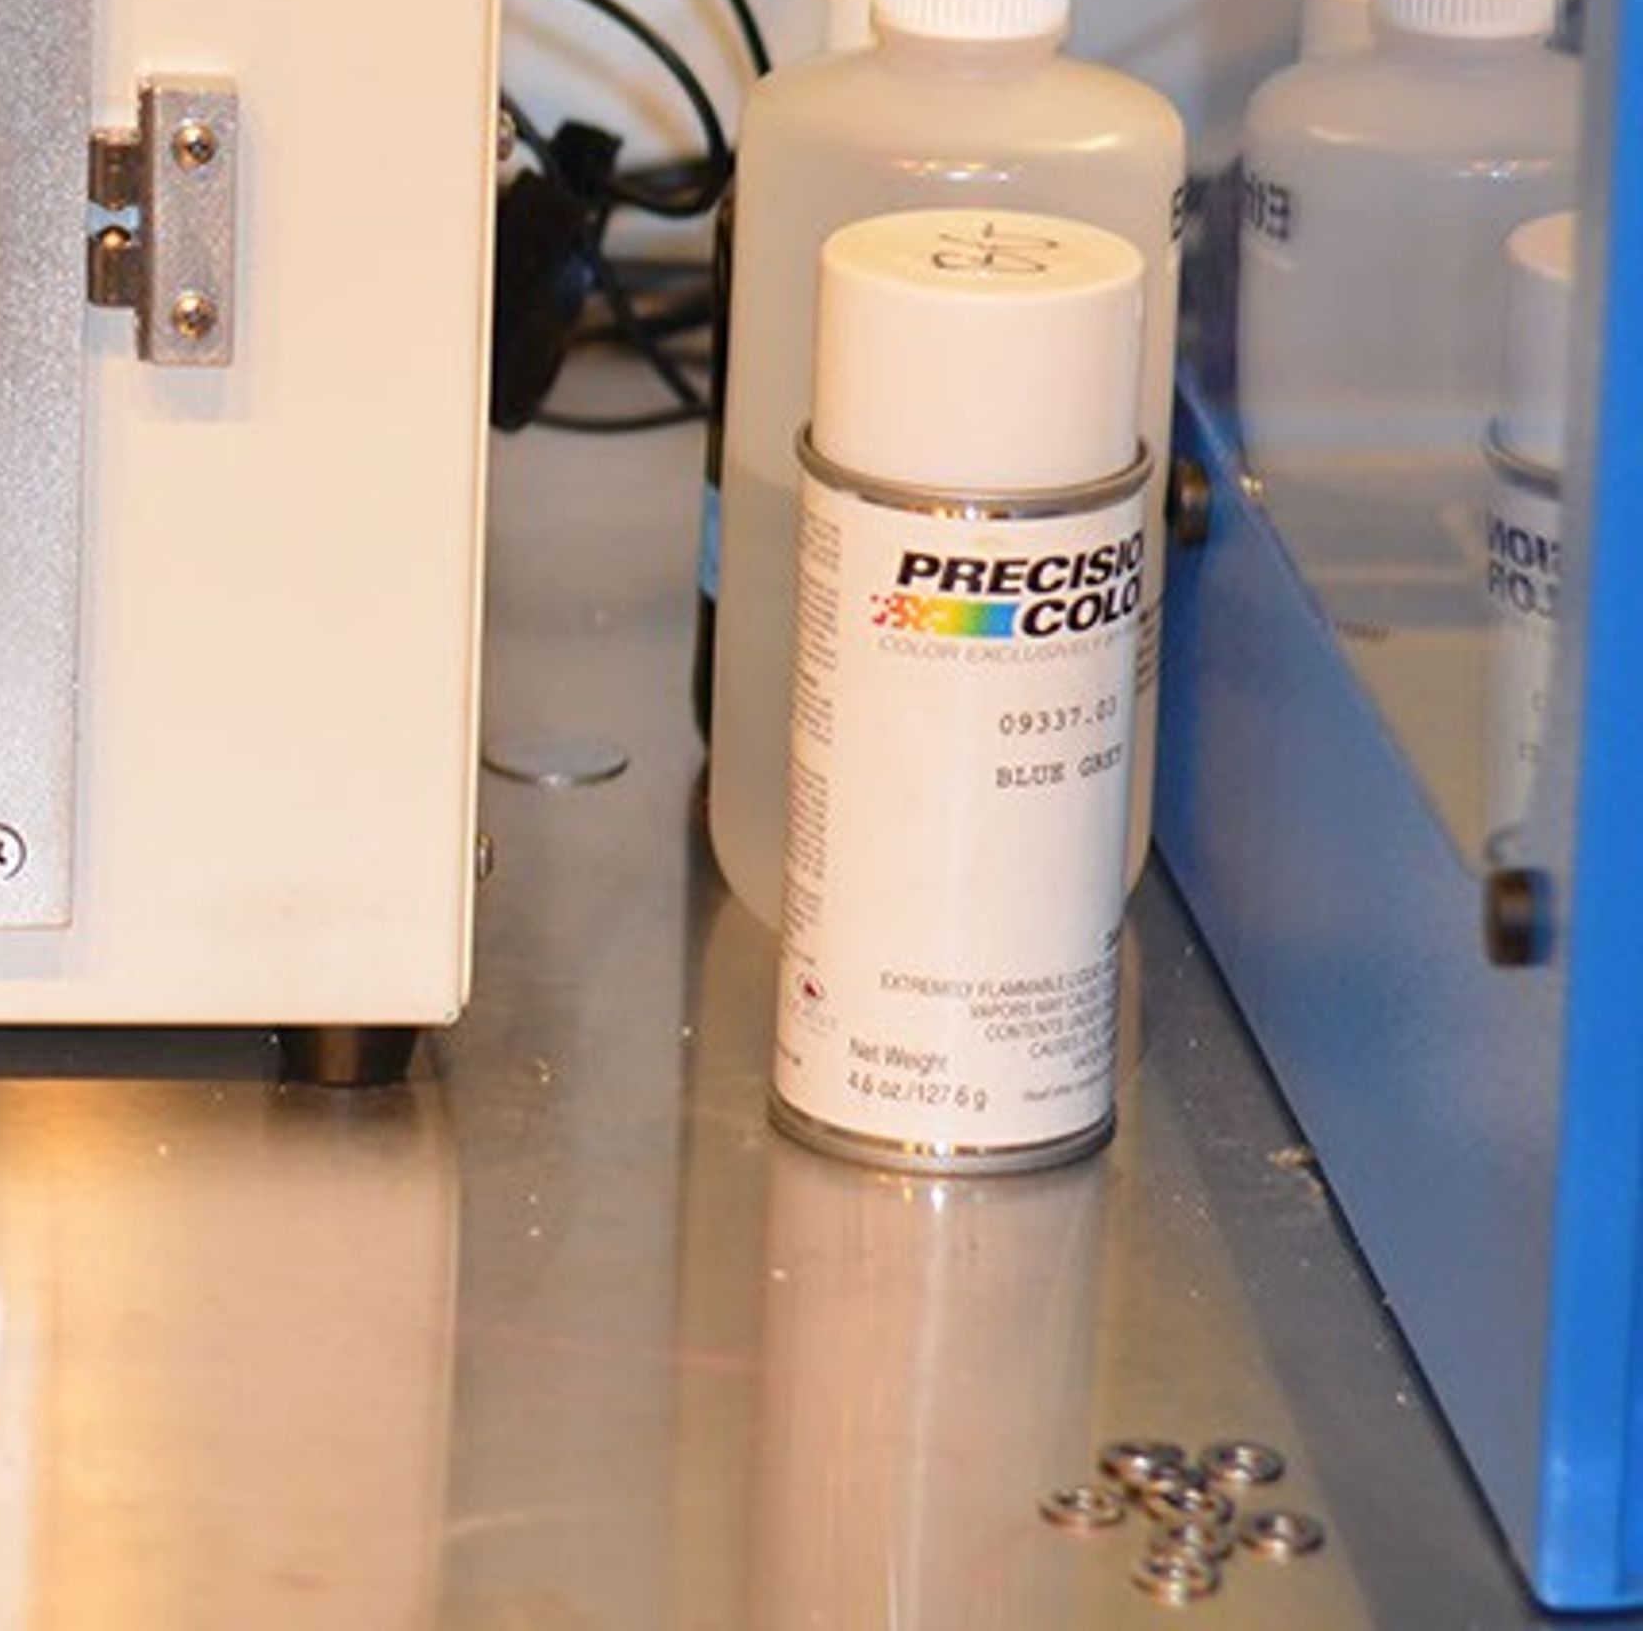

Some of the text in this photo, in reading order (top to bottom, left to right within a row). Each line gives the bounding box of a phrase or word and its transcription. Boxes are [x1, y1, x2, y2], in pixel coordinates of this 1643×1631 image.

[896, 530, 1144, 595] PRECISIO
[1021, 576, 1141, 639] COLO
[995, 762, 1065, 789] BLUE
[849, 1037, 949, 1075] Net Weight
